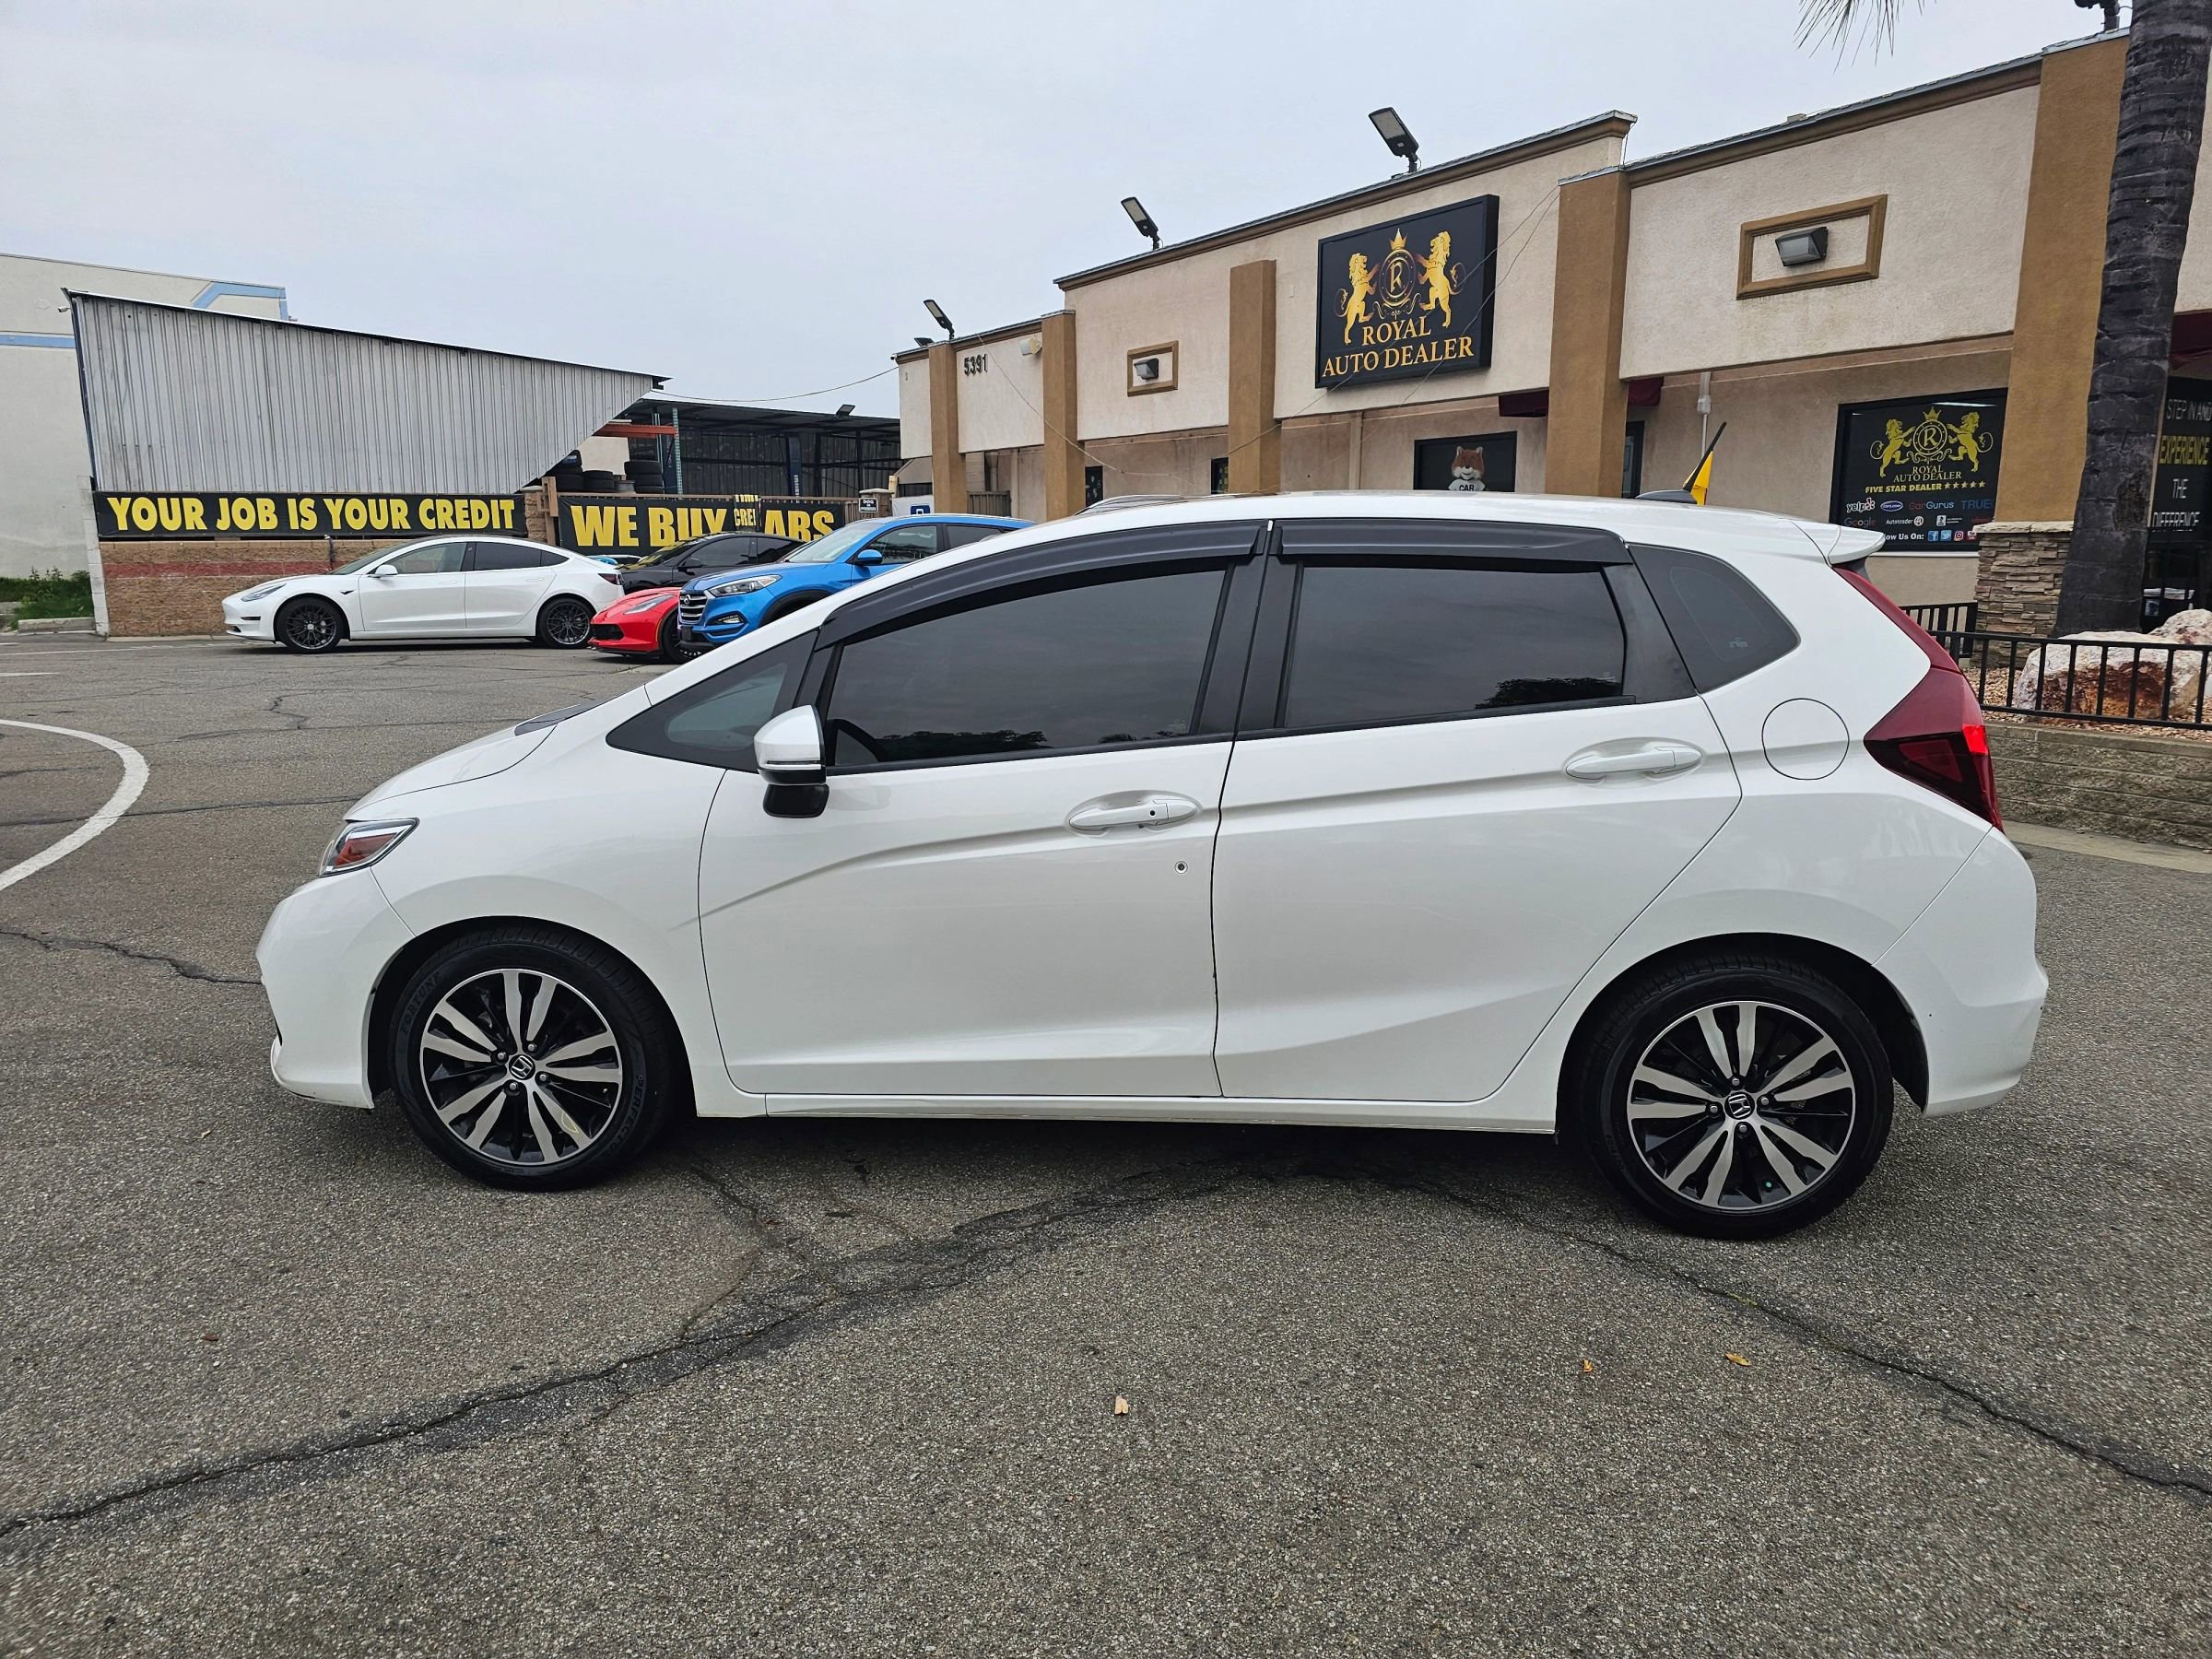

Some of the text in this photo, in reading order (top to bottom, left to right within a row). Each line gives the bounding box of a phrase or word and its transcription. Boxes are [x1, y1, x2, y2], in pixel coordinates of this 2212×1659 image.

[1361, 315, 1431, 347] ROYAL
[964, 354, 988, 376] 5391
[1321, 335, 1475, 378] AUTO DEALER
[2166, 398, 2187, 420] STEP
[2187, 400, 2196, 420] IN
[2159, 435, 2210, 465] EXPERIENCE
[1893, 471, 1962, 482] AUTO DEALER
[1912, 465, 1944, 475] ROYAL
[1909, 483, 1943, 491] DEALER
[2172, 478, 2189, 499] THE
[107, 497, 515, 532] YOUR JOB IS YOUR CREDIT
[1846, 500, 1868, 512] yelp
[571, 505, 835, 547] WE BUY ARS
[1844, 517, 1877, 528] Google
[1911, 532, 1924, 540] On:
